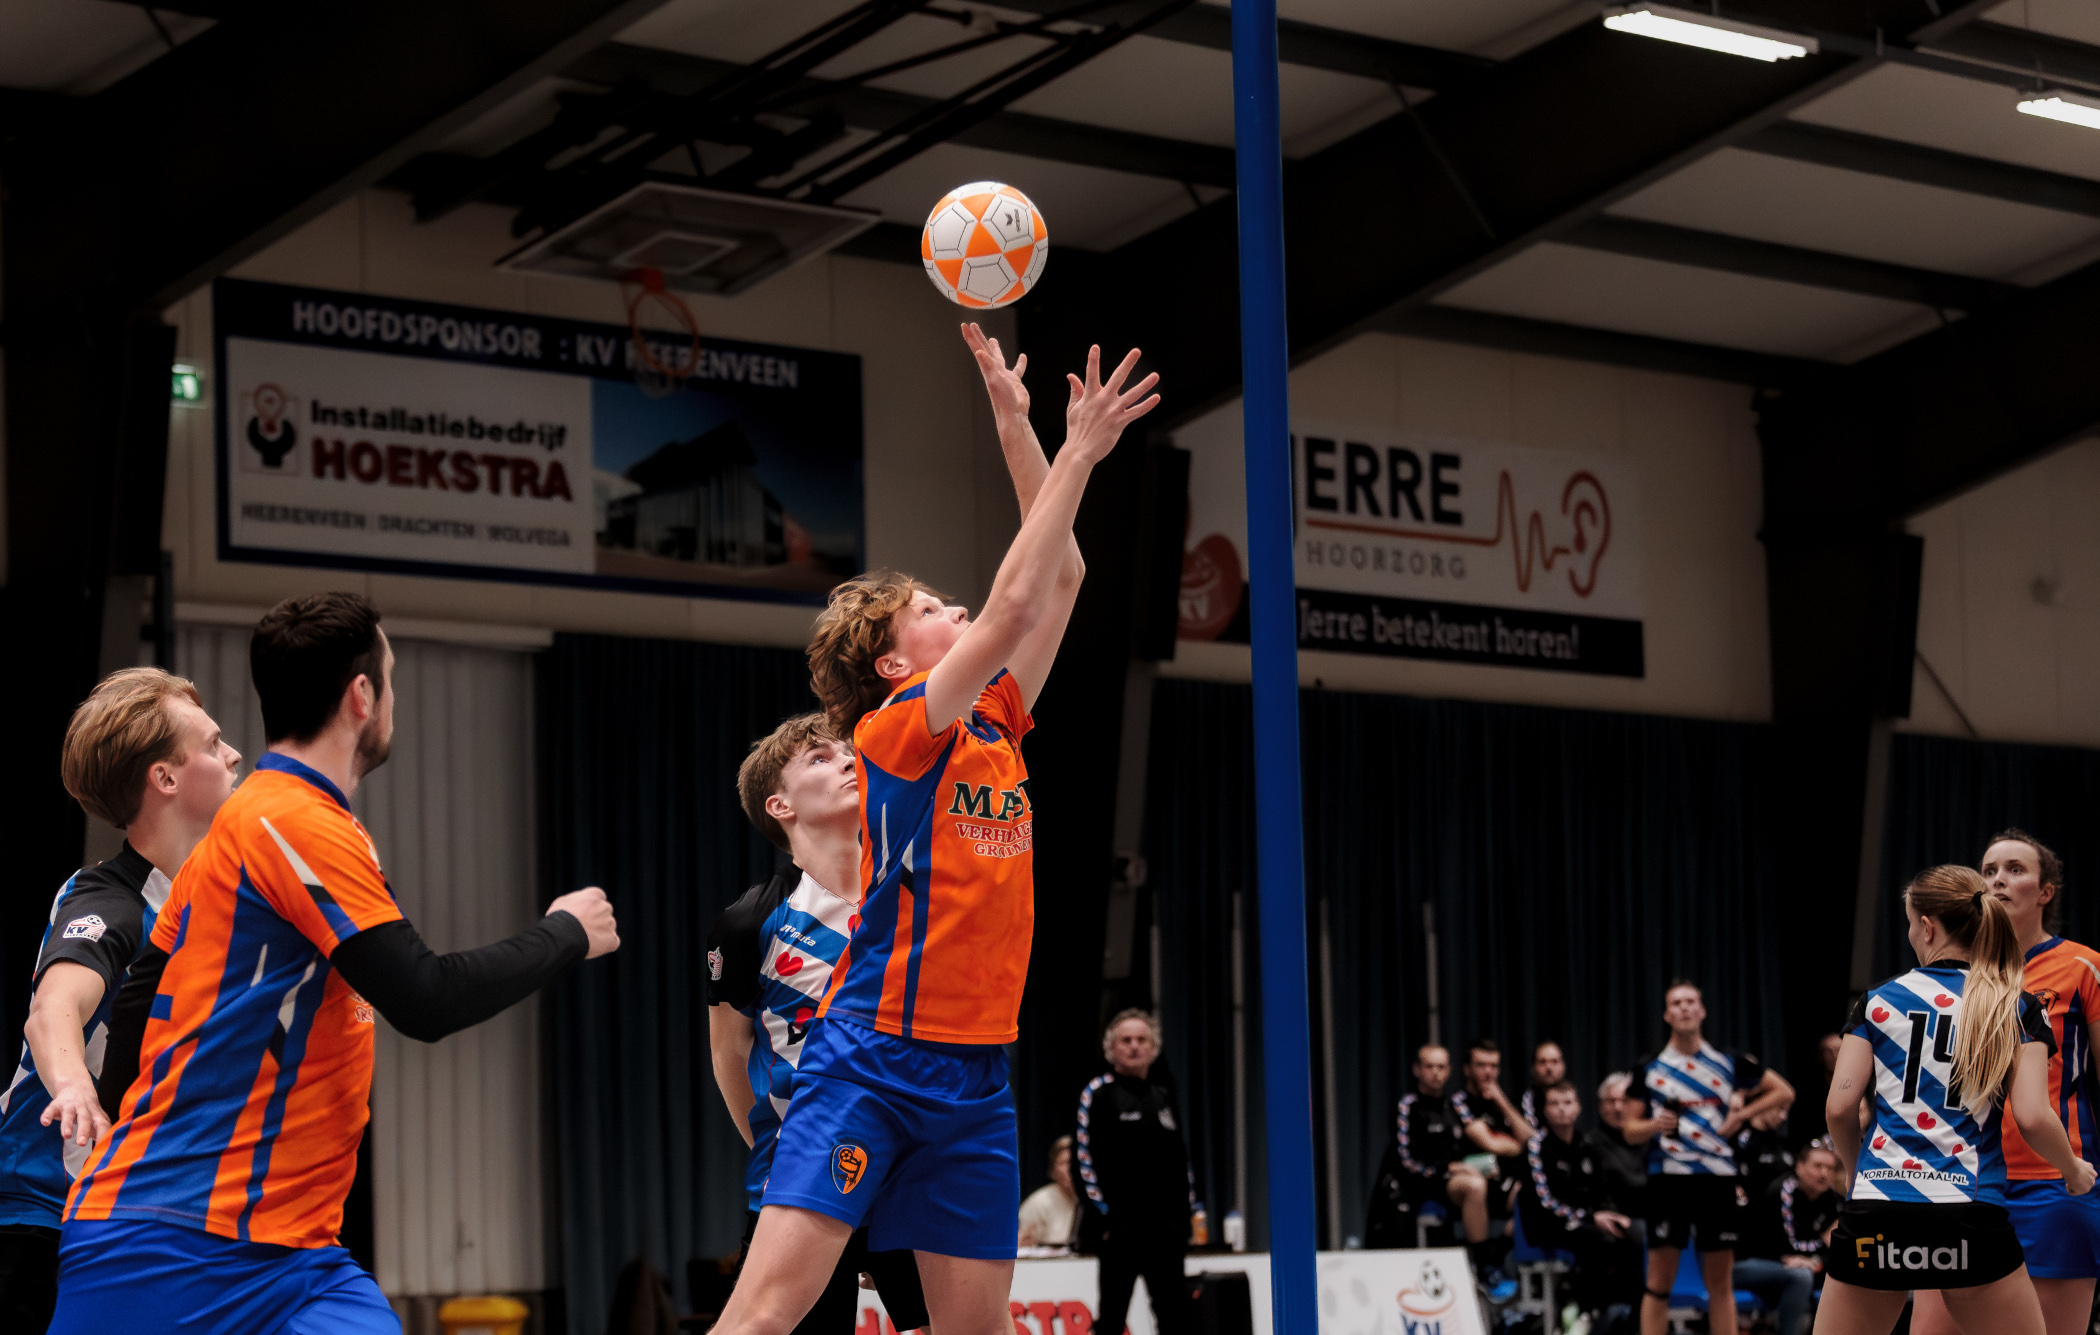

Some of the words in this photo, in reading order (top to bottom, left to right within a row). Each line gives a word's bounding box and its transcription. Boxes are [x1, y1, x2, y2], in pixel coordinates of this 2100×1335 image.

[291, 299, 543, 360] HOOFDSPONSOR
[575, 333, 617, 368] KV
[311, 399, 568, 451] Installatiebedrijf
[312, 437, 574, 502] HOEKSTRA
[241, 502, 367, 529] HEERENVEEN
[377, 510, 476, 538] DRACHTEN
[487, 523, 571, 548] WOLVEGA
[1306, 540, 1467, 580] HOORZORG
[1299, 598, 1368, 643] Jerre
[1370, 603, 1490, 653] betekent
[1494, 615, 1581, 661] horen!
[1901, 1010, 1964, 1111] 14
[1863, 1169, 1968, 1185] KORFBALTOTAAL.NL
[1856, 1233, 1969, 1271] Fitaal
